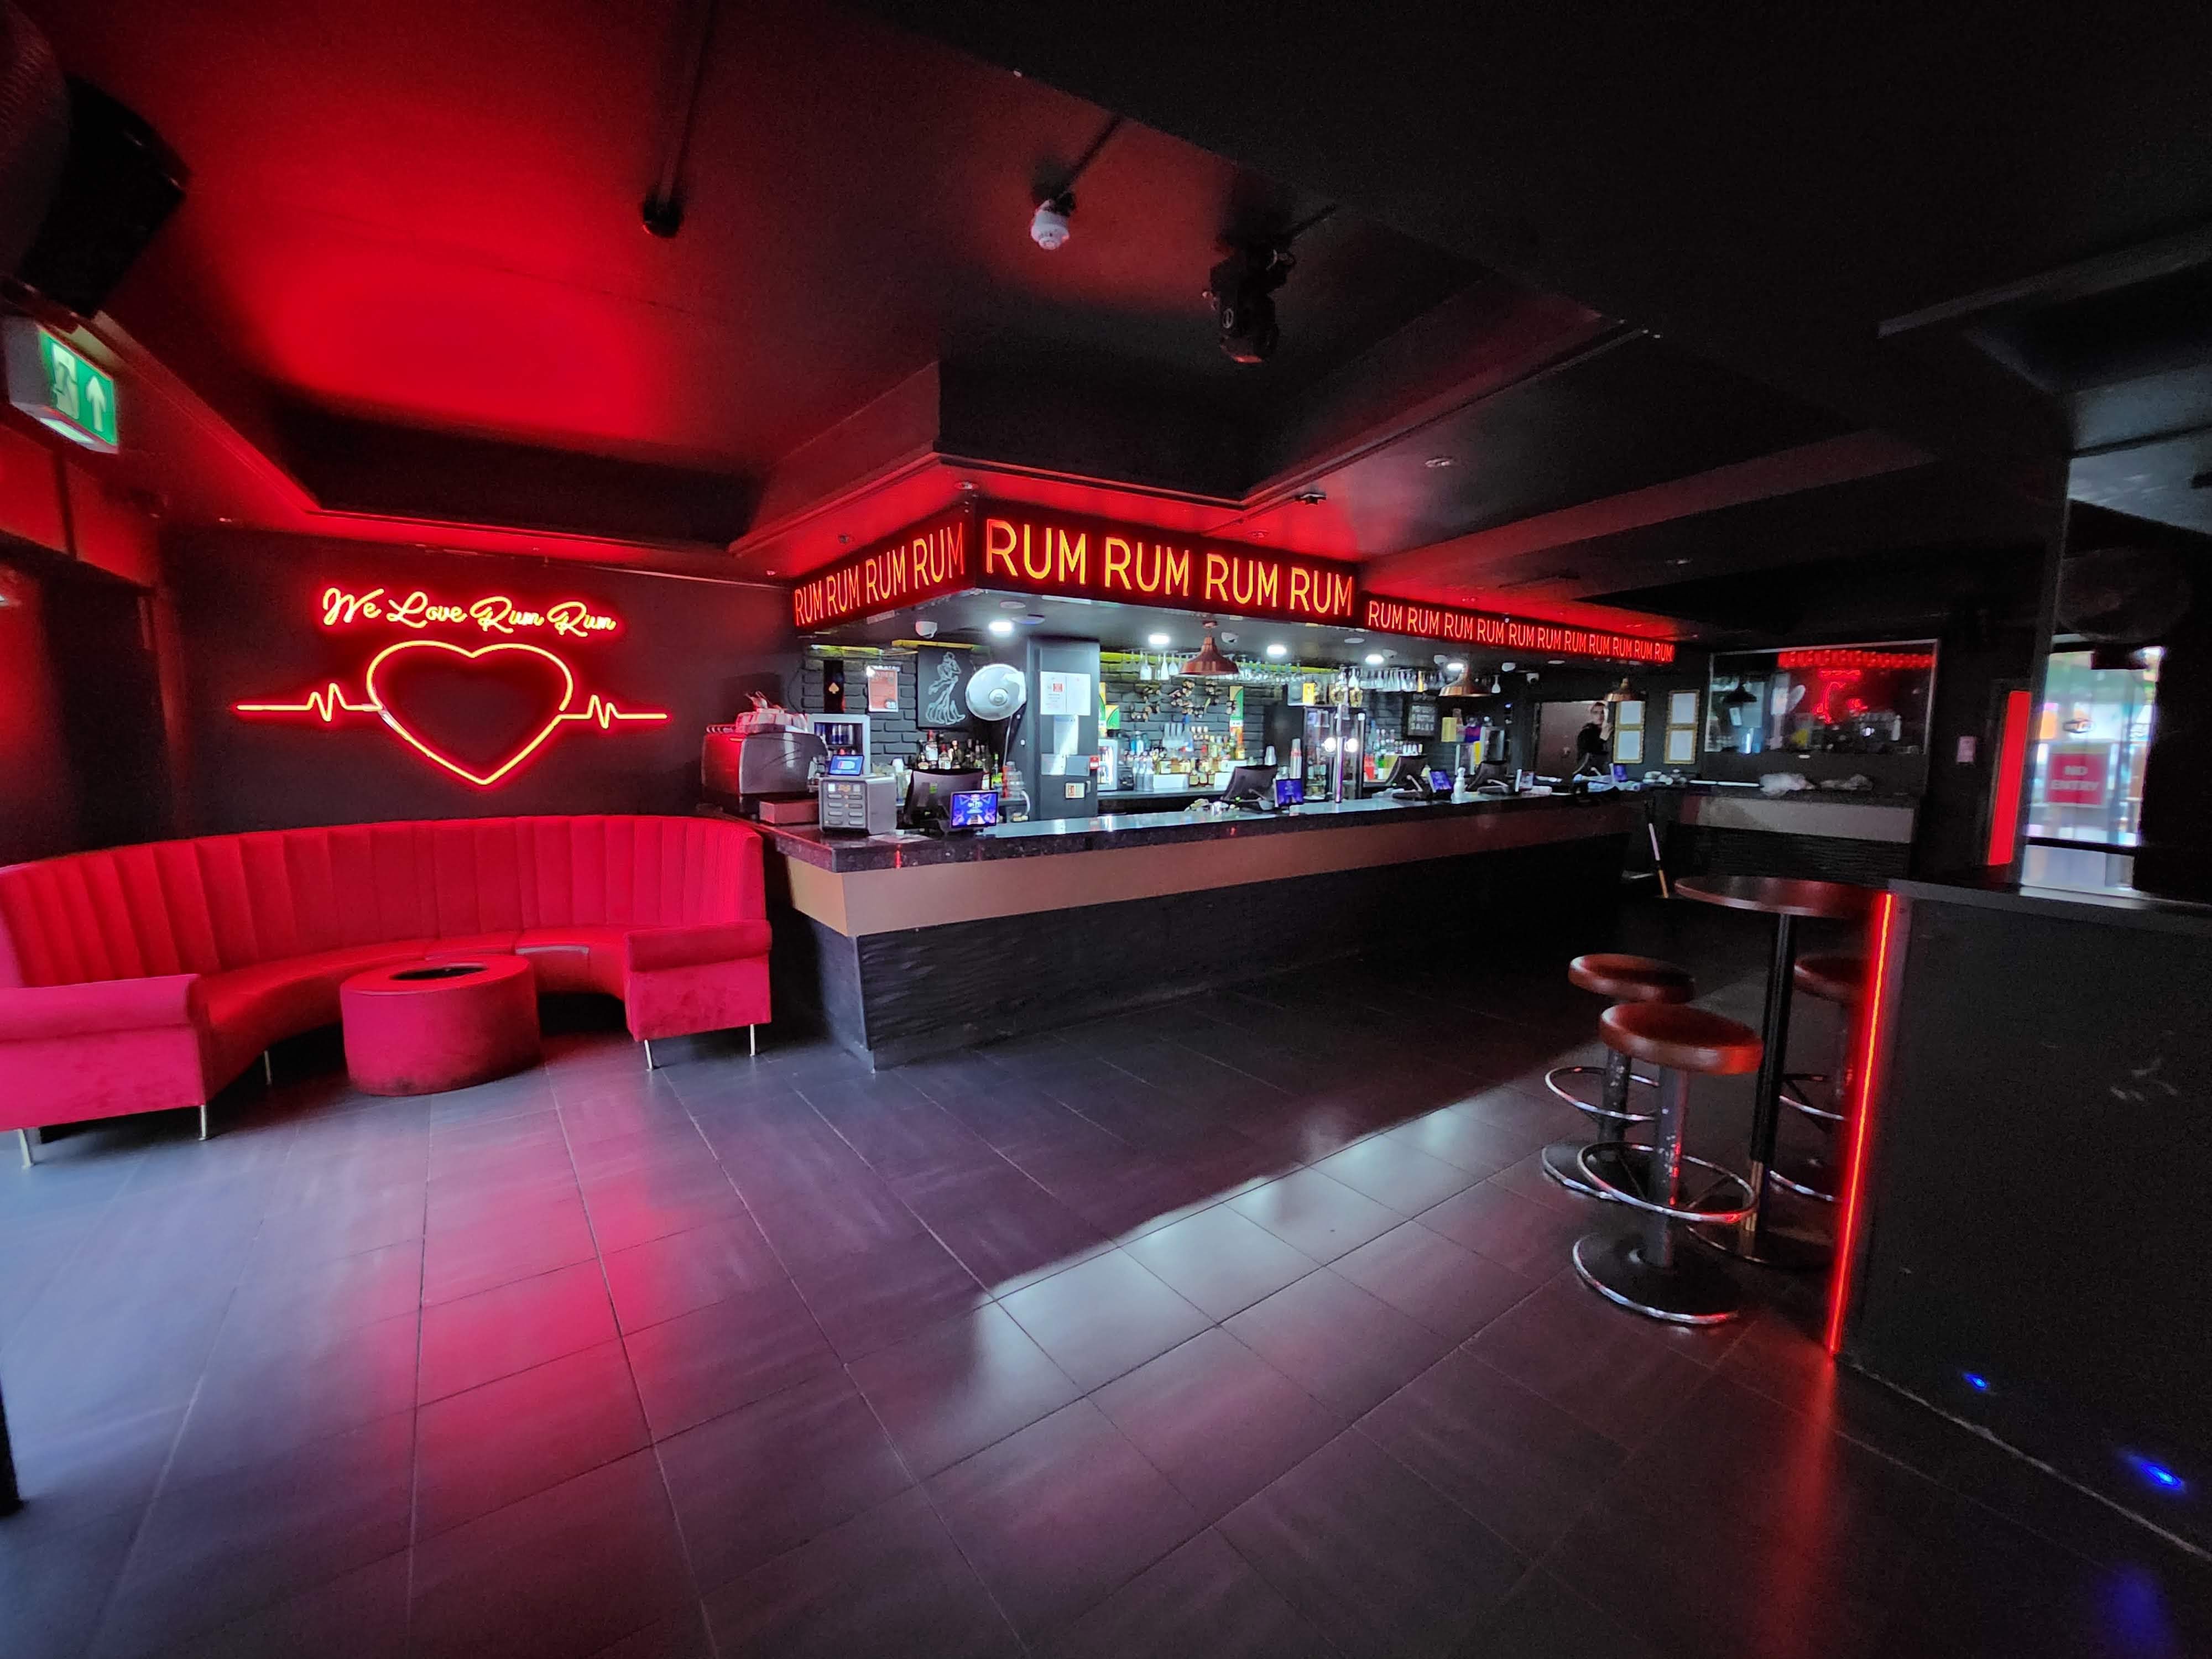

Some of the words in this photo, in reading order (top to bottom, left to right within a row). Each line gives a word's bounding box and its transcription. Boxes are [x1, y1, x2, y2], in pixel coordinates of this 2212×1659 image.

[794, 580, 823, 626] RUM
[826, 565, 860, 614] RUM
[865, 545, 906, 604] RUM
[913, 522, 965, 589] RUM
[987, 519, 1086, 585] RUM
[1104, 537, 1189, 596] RUM
[1204, 554, 1277, 607] RUM
[1290, 567, 1353, 615] RUM
[322, 587, 384, 625] We
[386, 592, 467, 628] Love
[469, 596, 545, 634] Rum
[547, 601, 616, 637] Rum
[1368, 601, 1402, 630] RUM
[1407, 607, 1439, 635] RUM
[1444, 613, 1473, 640] RUM
[1477, 619, 1504, 644] RUM
[1509, 624, 1535, 648] RUM
[1537, 628, 1562, 651] RUM
[1564, 630, 1586, 653] RUM
[1589, 634, 1610, 656] RUM
[1613, 637, 1632, 658] RUM
[1634, 640, 1653, 660] RUM
[2051, 779, 2099, 791] ENTRY
[2064, 765, 2088, 776] NO
